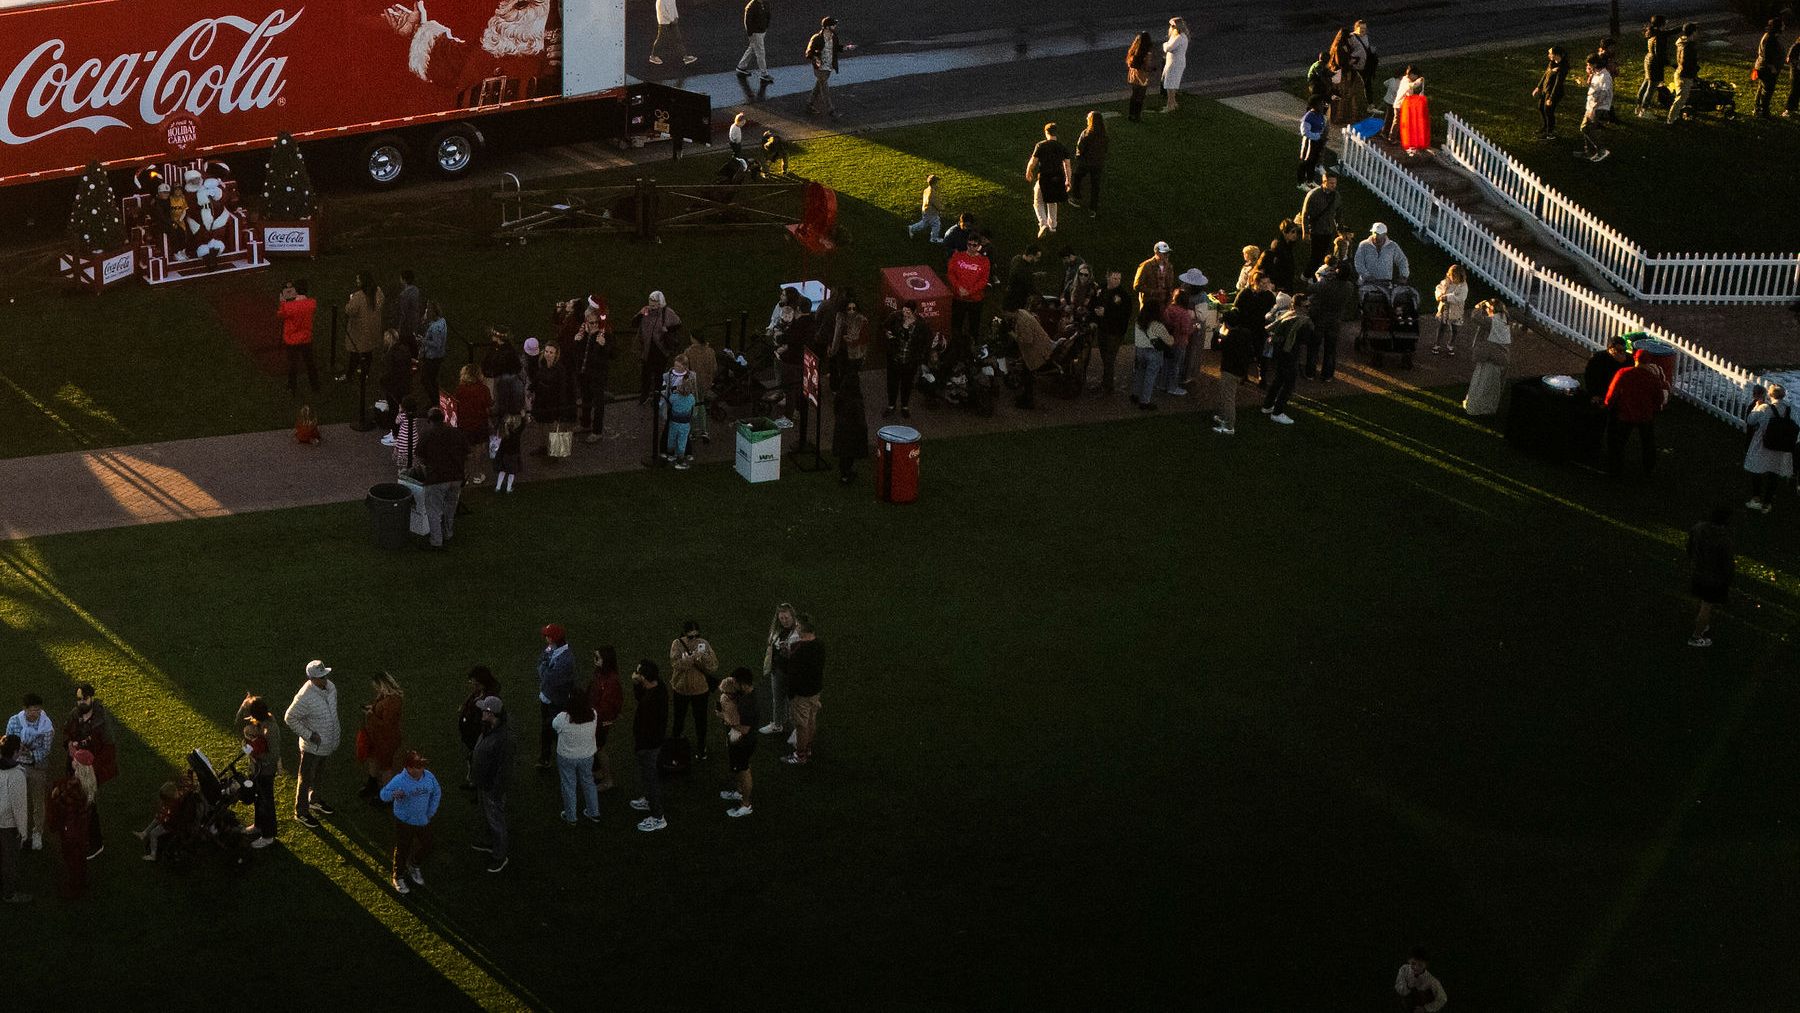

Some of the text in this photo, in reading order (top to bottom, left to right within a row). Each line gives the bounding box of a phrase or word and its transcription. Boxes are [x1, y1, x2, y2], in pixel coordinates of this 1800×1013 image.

[168, 126, 196, 137] HOLIDAY
[168, 133, 196, 144] CARAVAN
[268, 231, 305, 243] Coca-Cola
